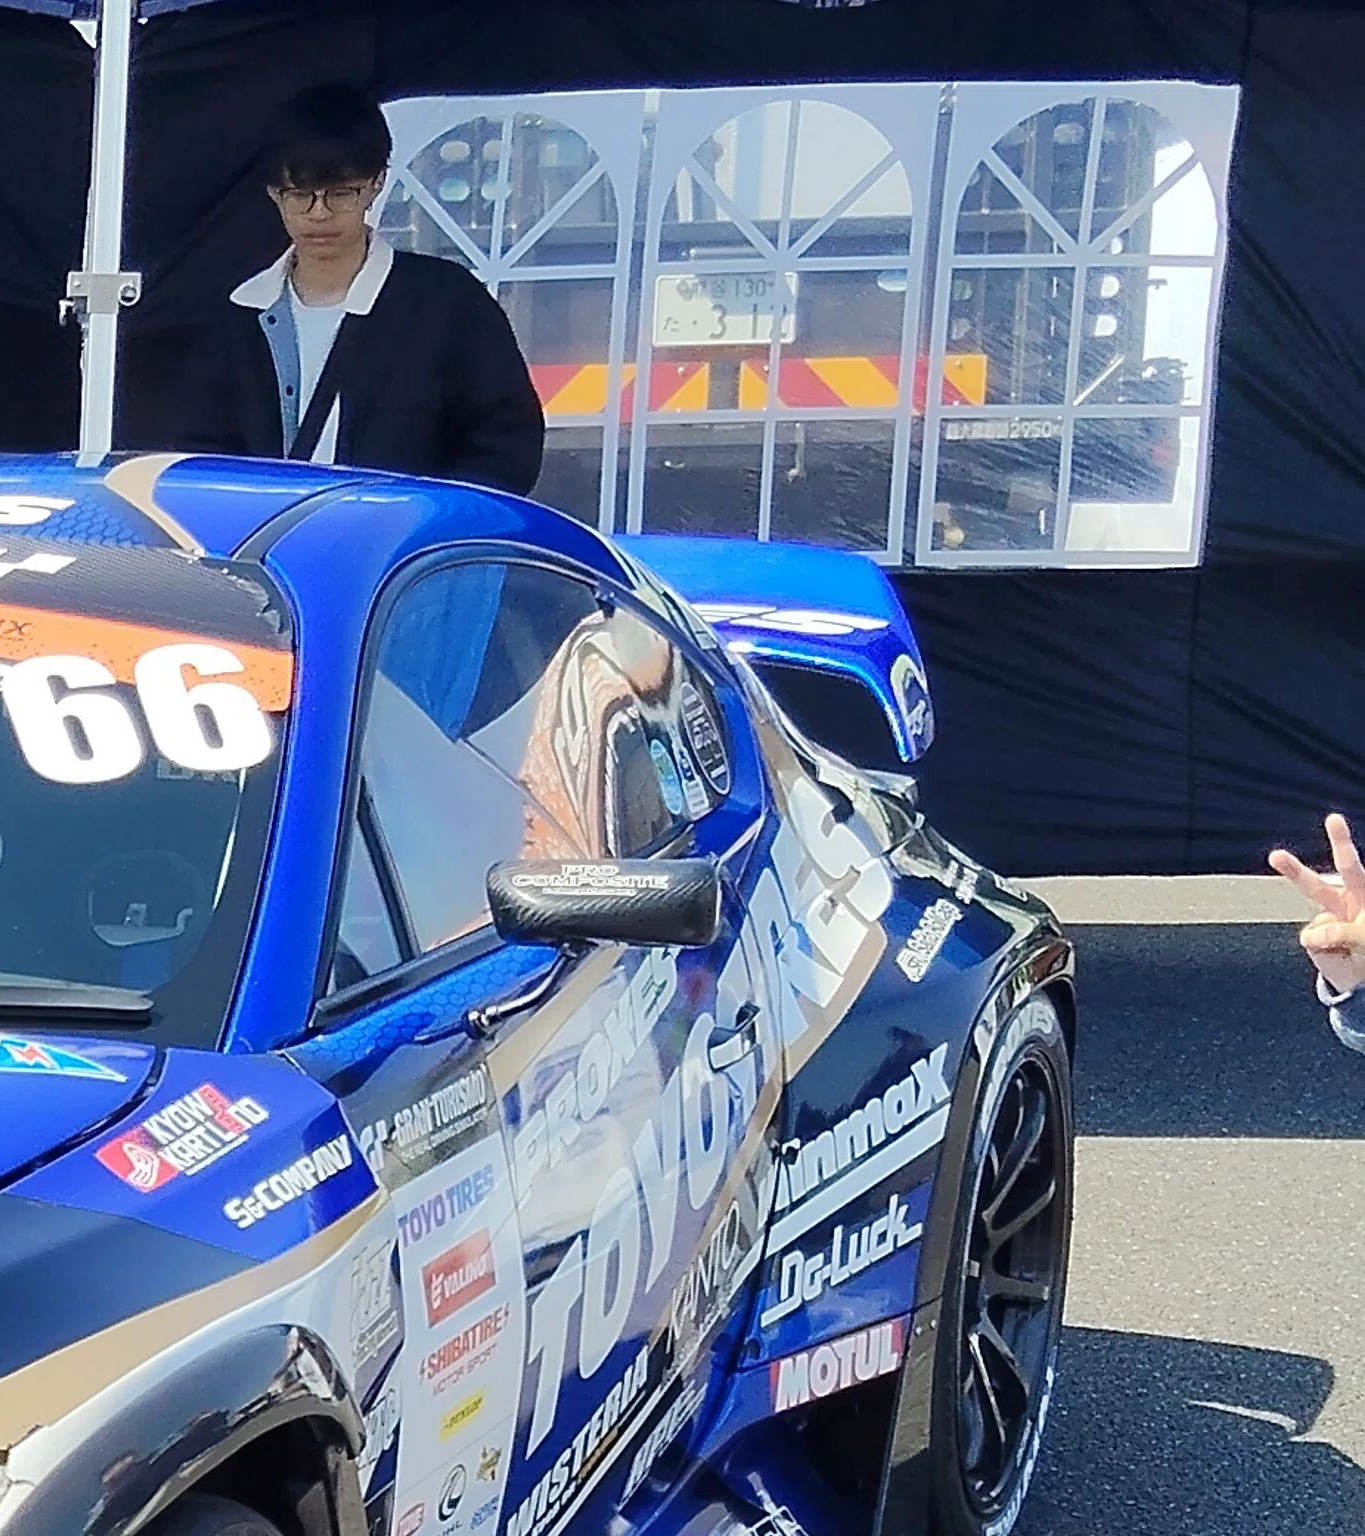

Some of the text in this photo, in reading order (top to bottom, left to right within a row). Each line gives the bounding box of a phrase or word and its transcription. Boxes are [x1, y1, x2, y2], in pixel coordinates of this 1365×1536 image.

[0, 642, 273, 786] 66
[398, 1163, 494, 1249] TOYO TIRES
[426, 1305, 503, 1381] SHIBATIRE
[774, 1324, 902, 1413] MOTUL
